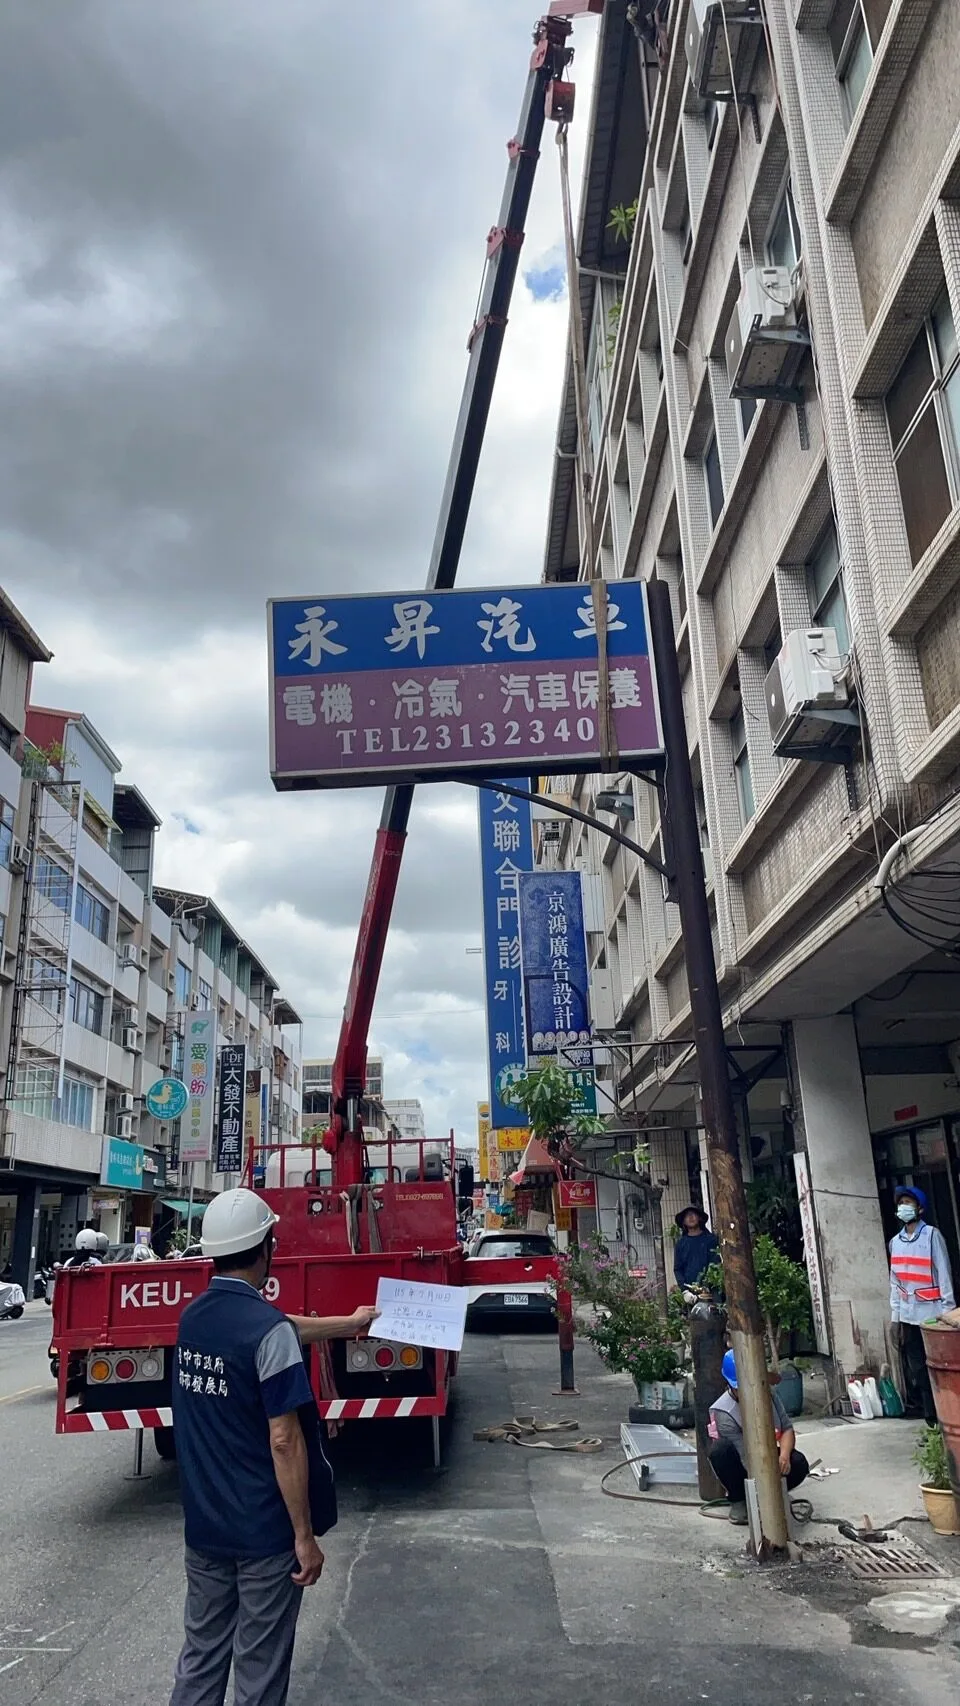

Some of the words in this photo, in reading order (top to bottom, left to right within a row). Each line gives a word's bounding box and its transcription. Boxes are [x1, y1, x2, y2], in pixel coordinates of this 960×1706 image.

[336, 716, 596, 755] TEL23132340
[546, 891, 574, 1030] 京鴻廣告設計
[221, 1067, 241, 1153] 大發不動產
[178, 1346, 225, 1375] 中市政府
